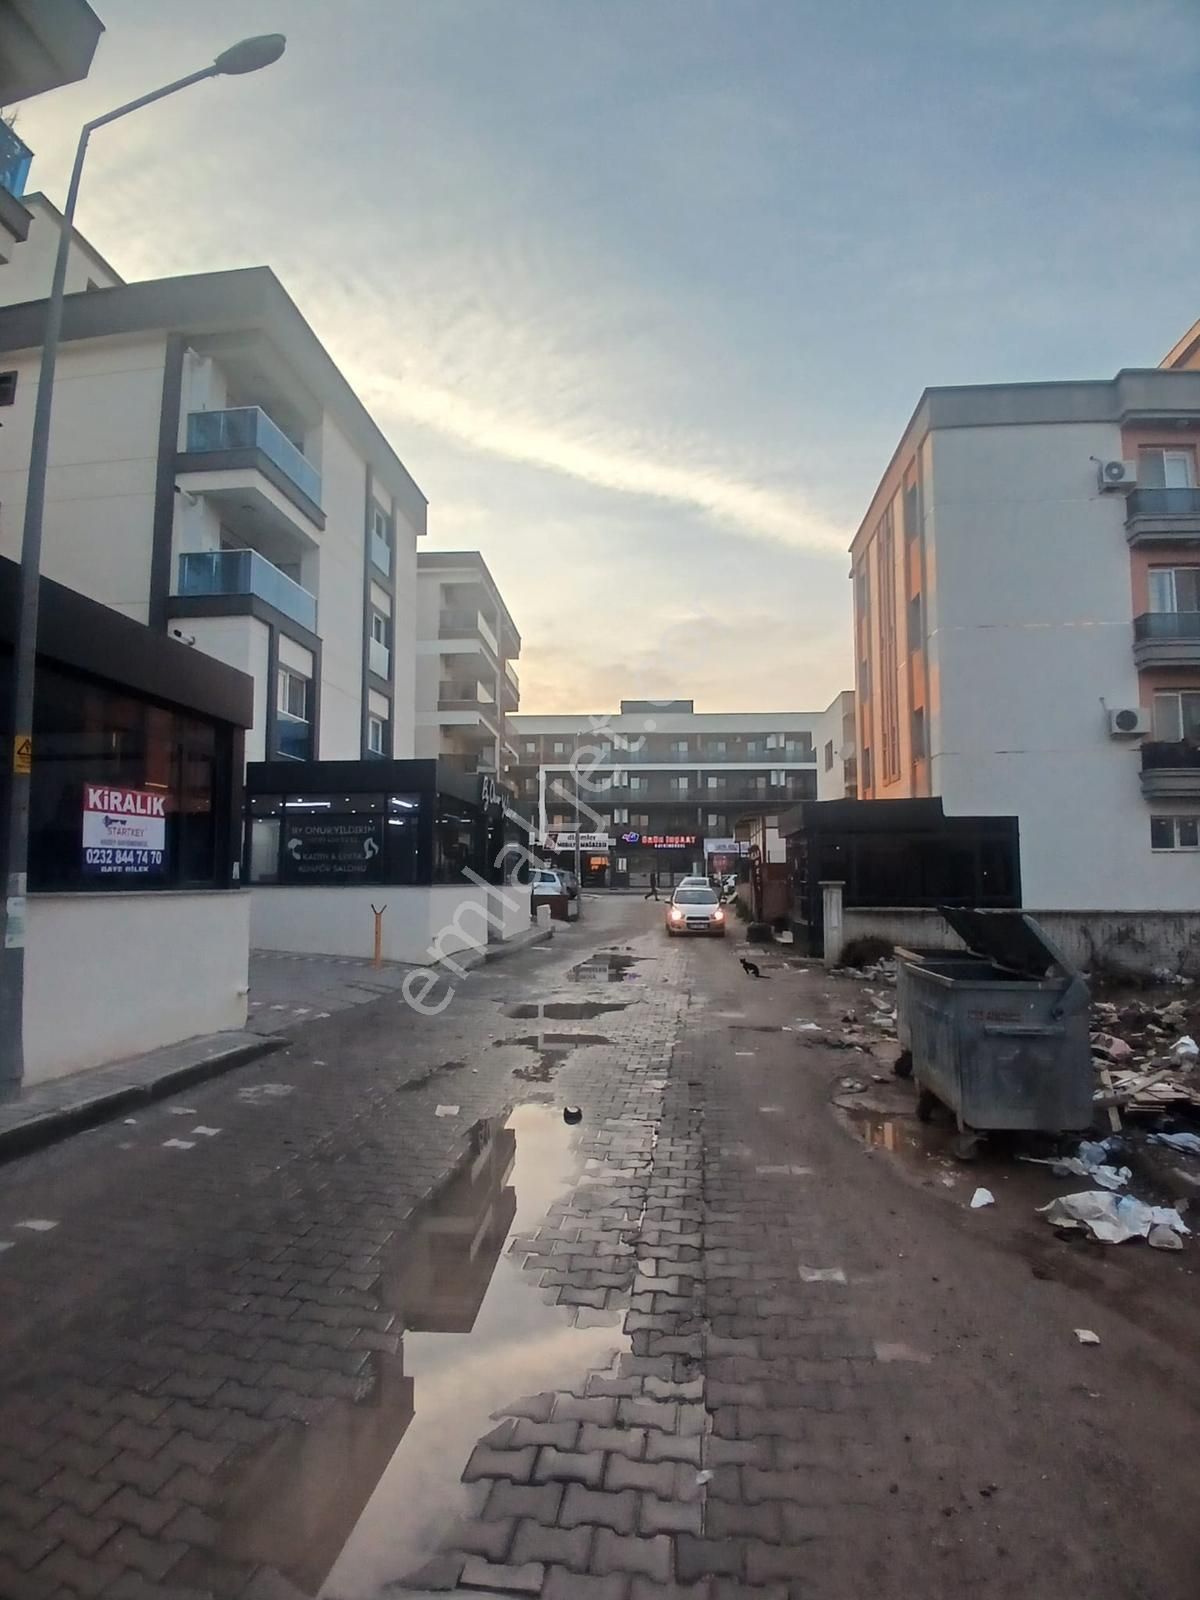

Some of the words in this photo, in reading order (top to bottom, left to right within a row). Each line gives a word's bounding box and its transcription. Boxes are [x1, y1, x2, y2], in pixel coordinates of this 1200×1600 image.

[86, 849, 113, 864] 0232
[115, 850, 134, 865] 844
[136, 850, 149, 865] 74
[150, 850, 163, 865] 70
